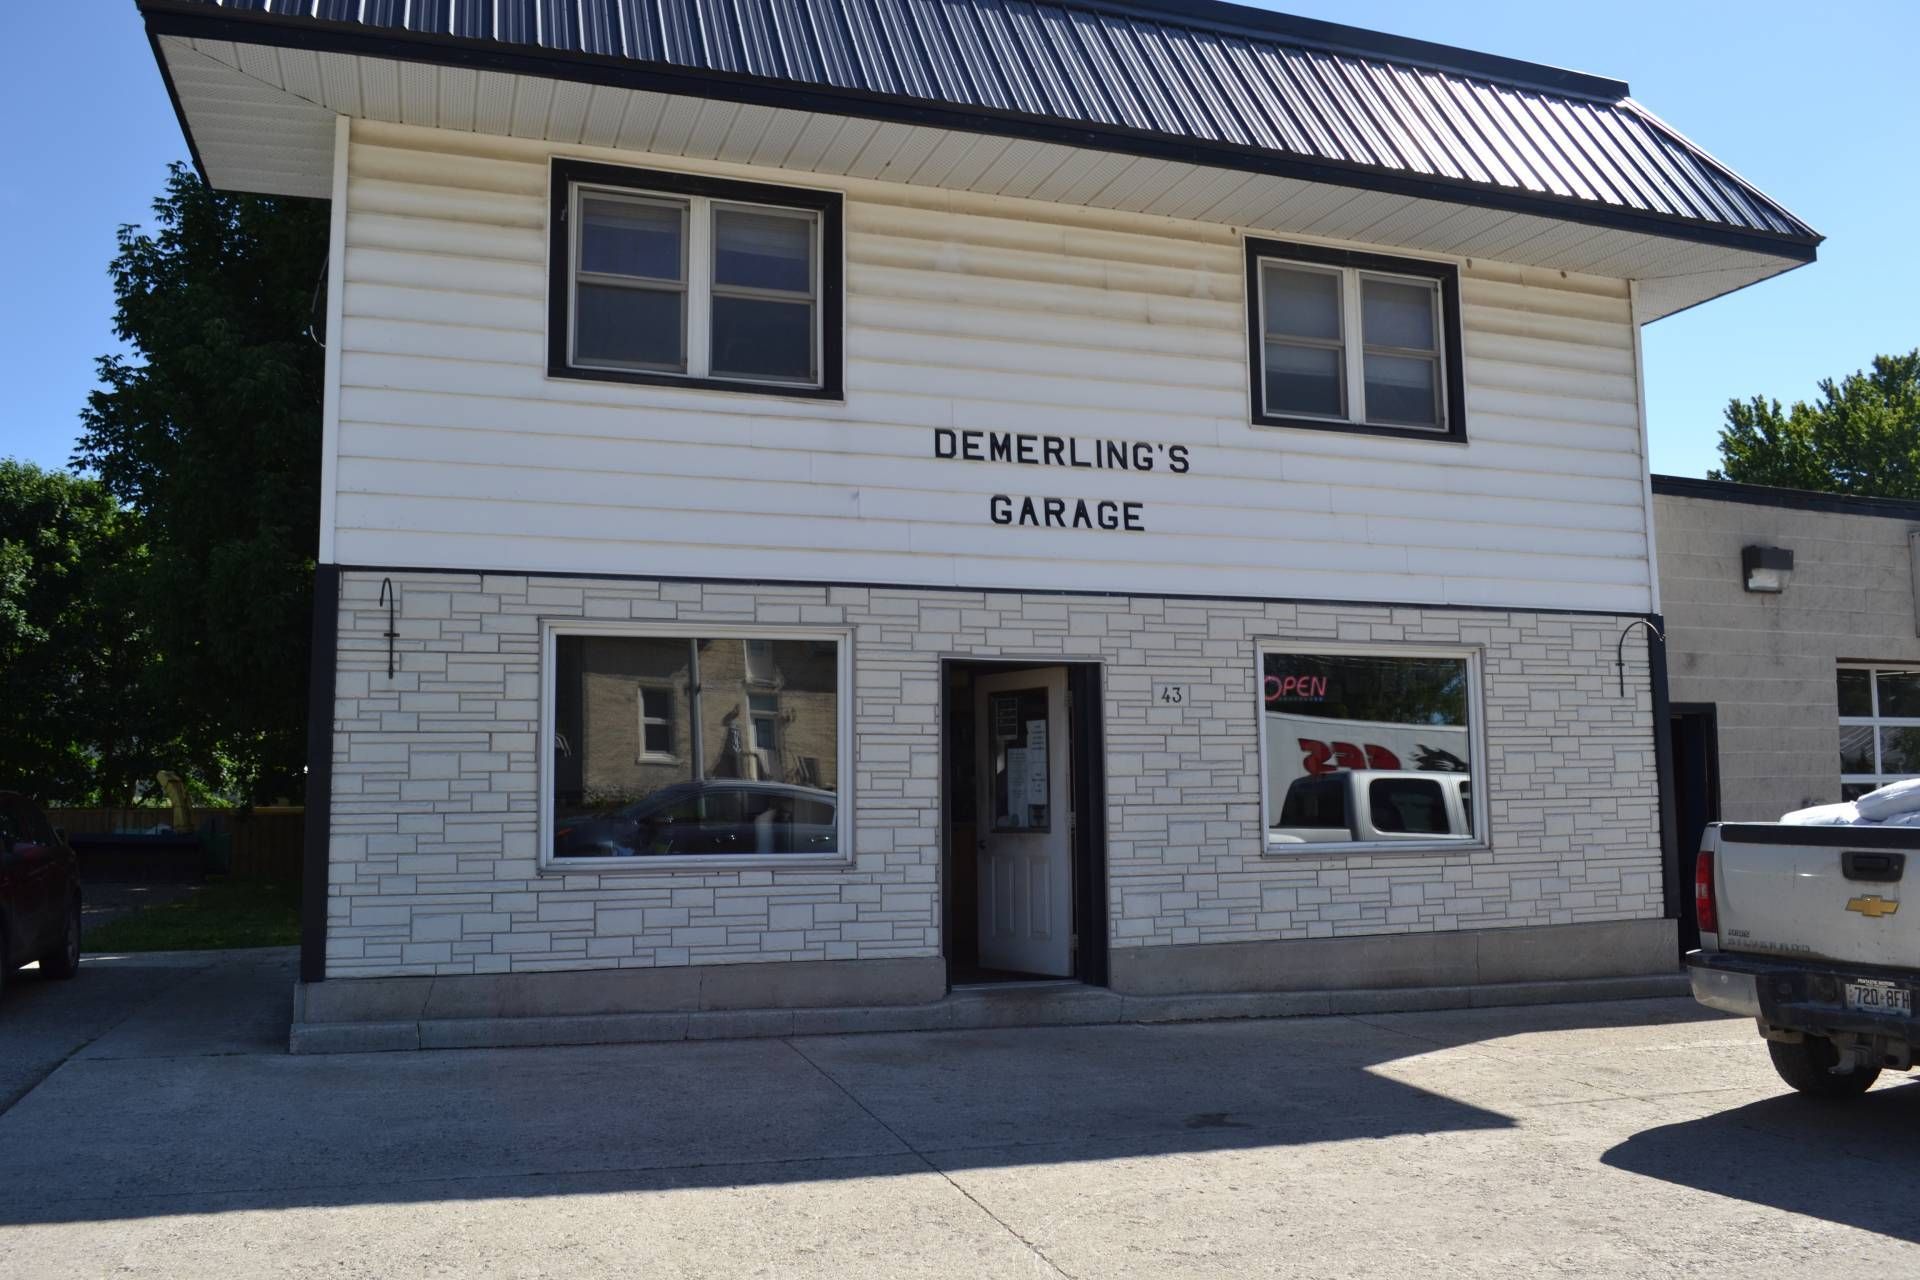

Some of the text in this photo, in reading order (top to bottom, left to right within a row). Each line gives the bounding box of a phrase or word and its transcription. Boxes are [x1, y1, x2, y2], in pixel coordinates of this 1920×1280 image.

[934, 428, 1190, 474] DEMERLING'S
[990, 494, 1145, 531] GARAGE
[1161, 686, 1182, 703] 43
[1264, 675, 1328, 701] OPEN
